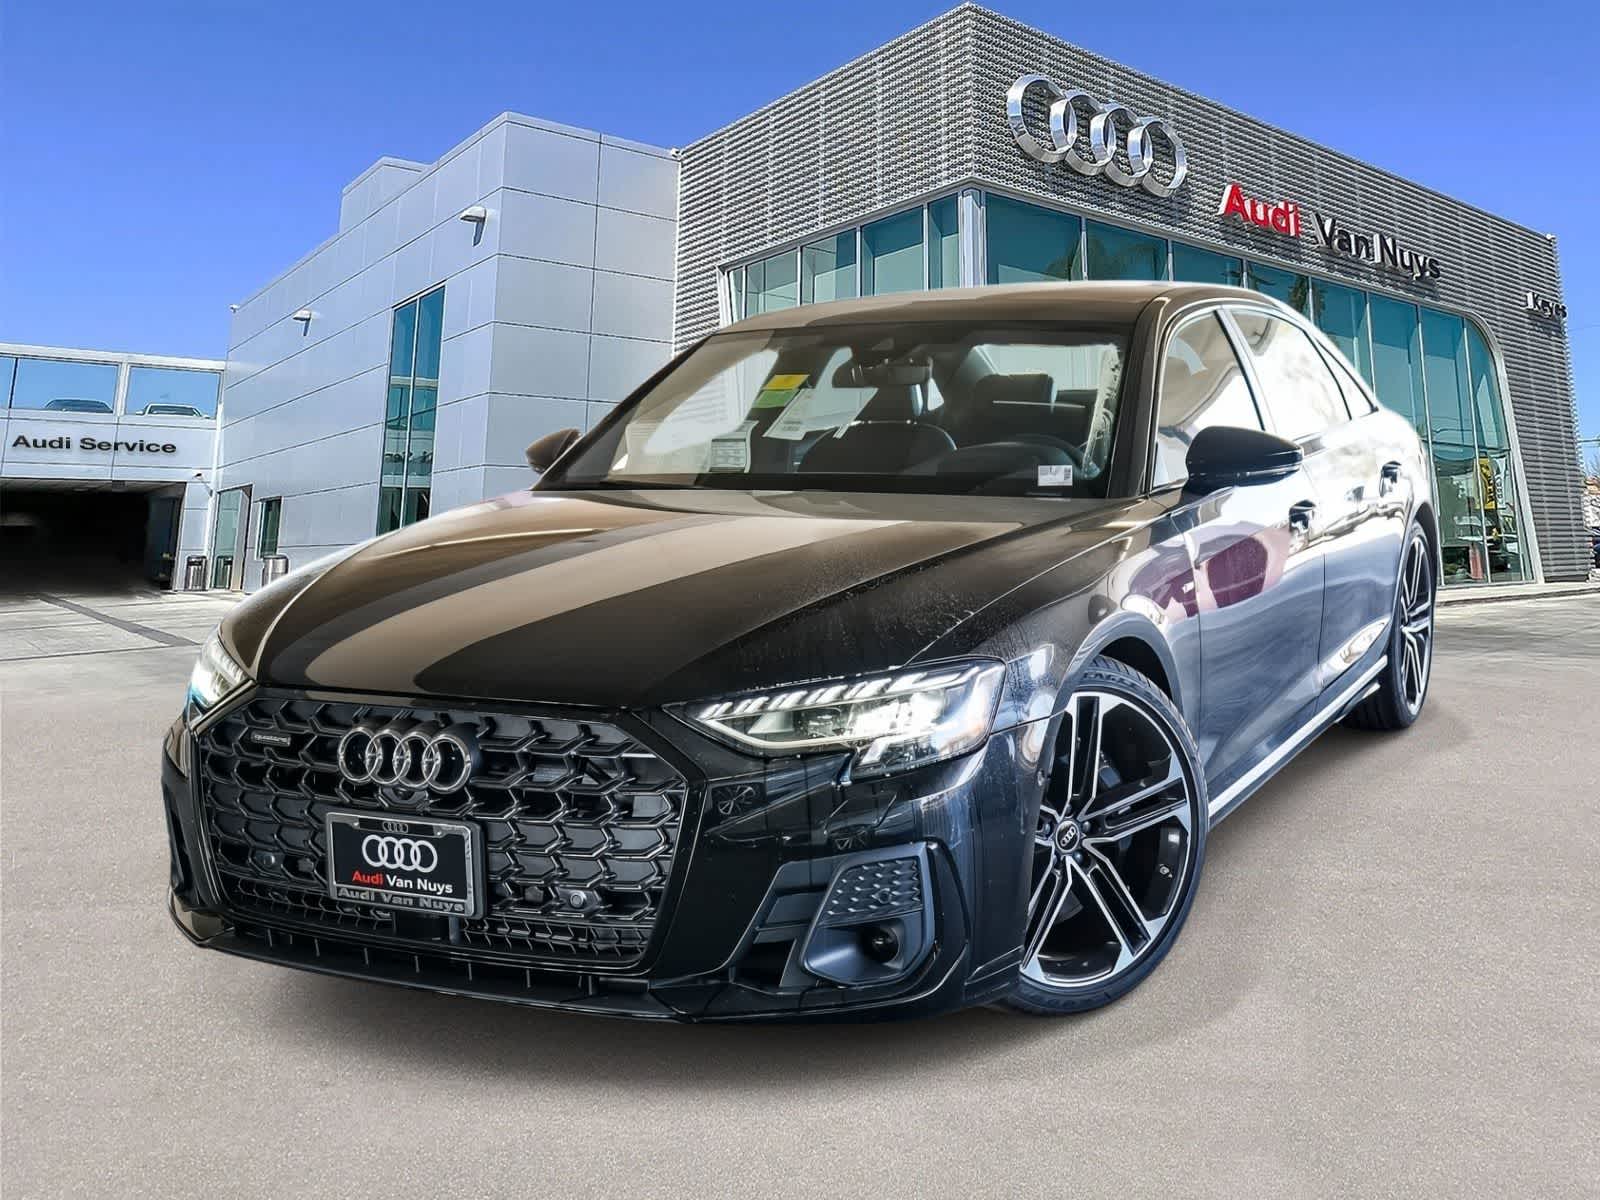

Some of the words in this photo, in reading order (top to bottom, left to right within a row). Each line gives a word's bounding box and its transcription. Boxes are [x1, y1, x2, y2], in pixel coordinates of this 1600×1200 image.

[1217, 183, 1301, 237] Audi
[1312, 212, 1370, 259] Van
[1373, 232, 1441, 280] Nuys
[12, 435, 71, 449] Audi
[80, 437, 177, 453] Service
[352, 871, 383, 885] Audi
[386, 875, 413, 889] Van
[417, 878, 453, 895] Nuys
[338, 887, 375, 901] Audi
[380, 893, 414, 905] Van
[419, 897, 465, 912] Nuys
